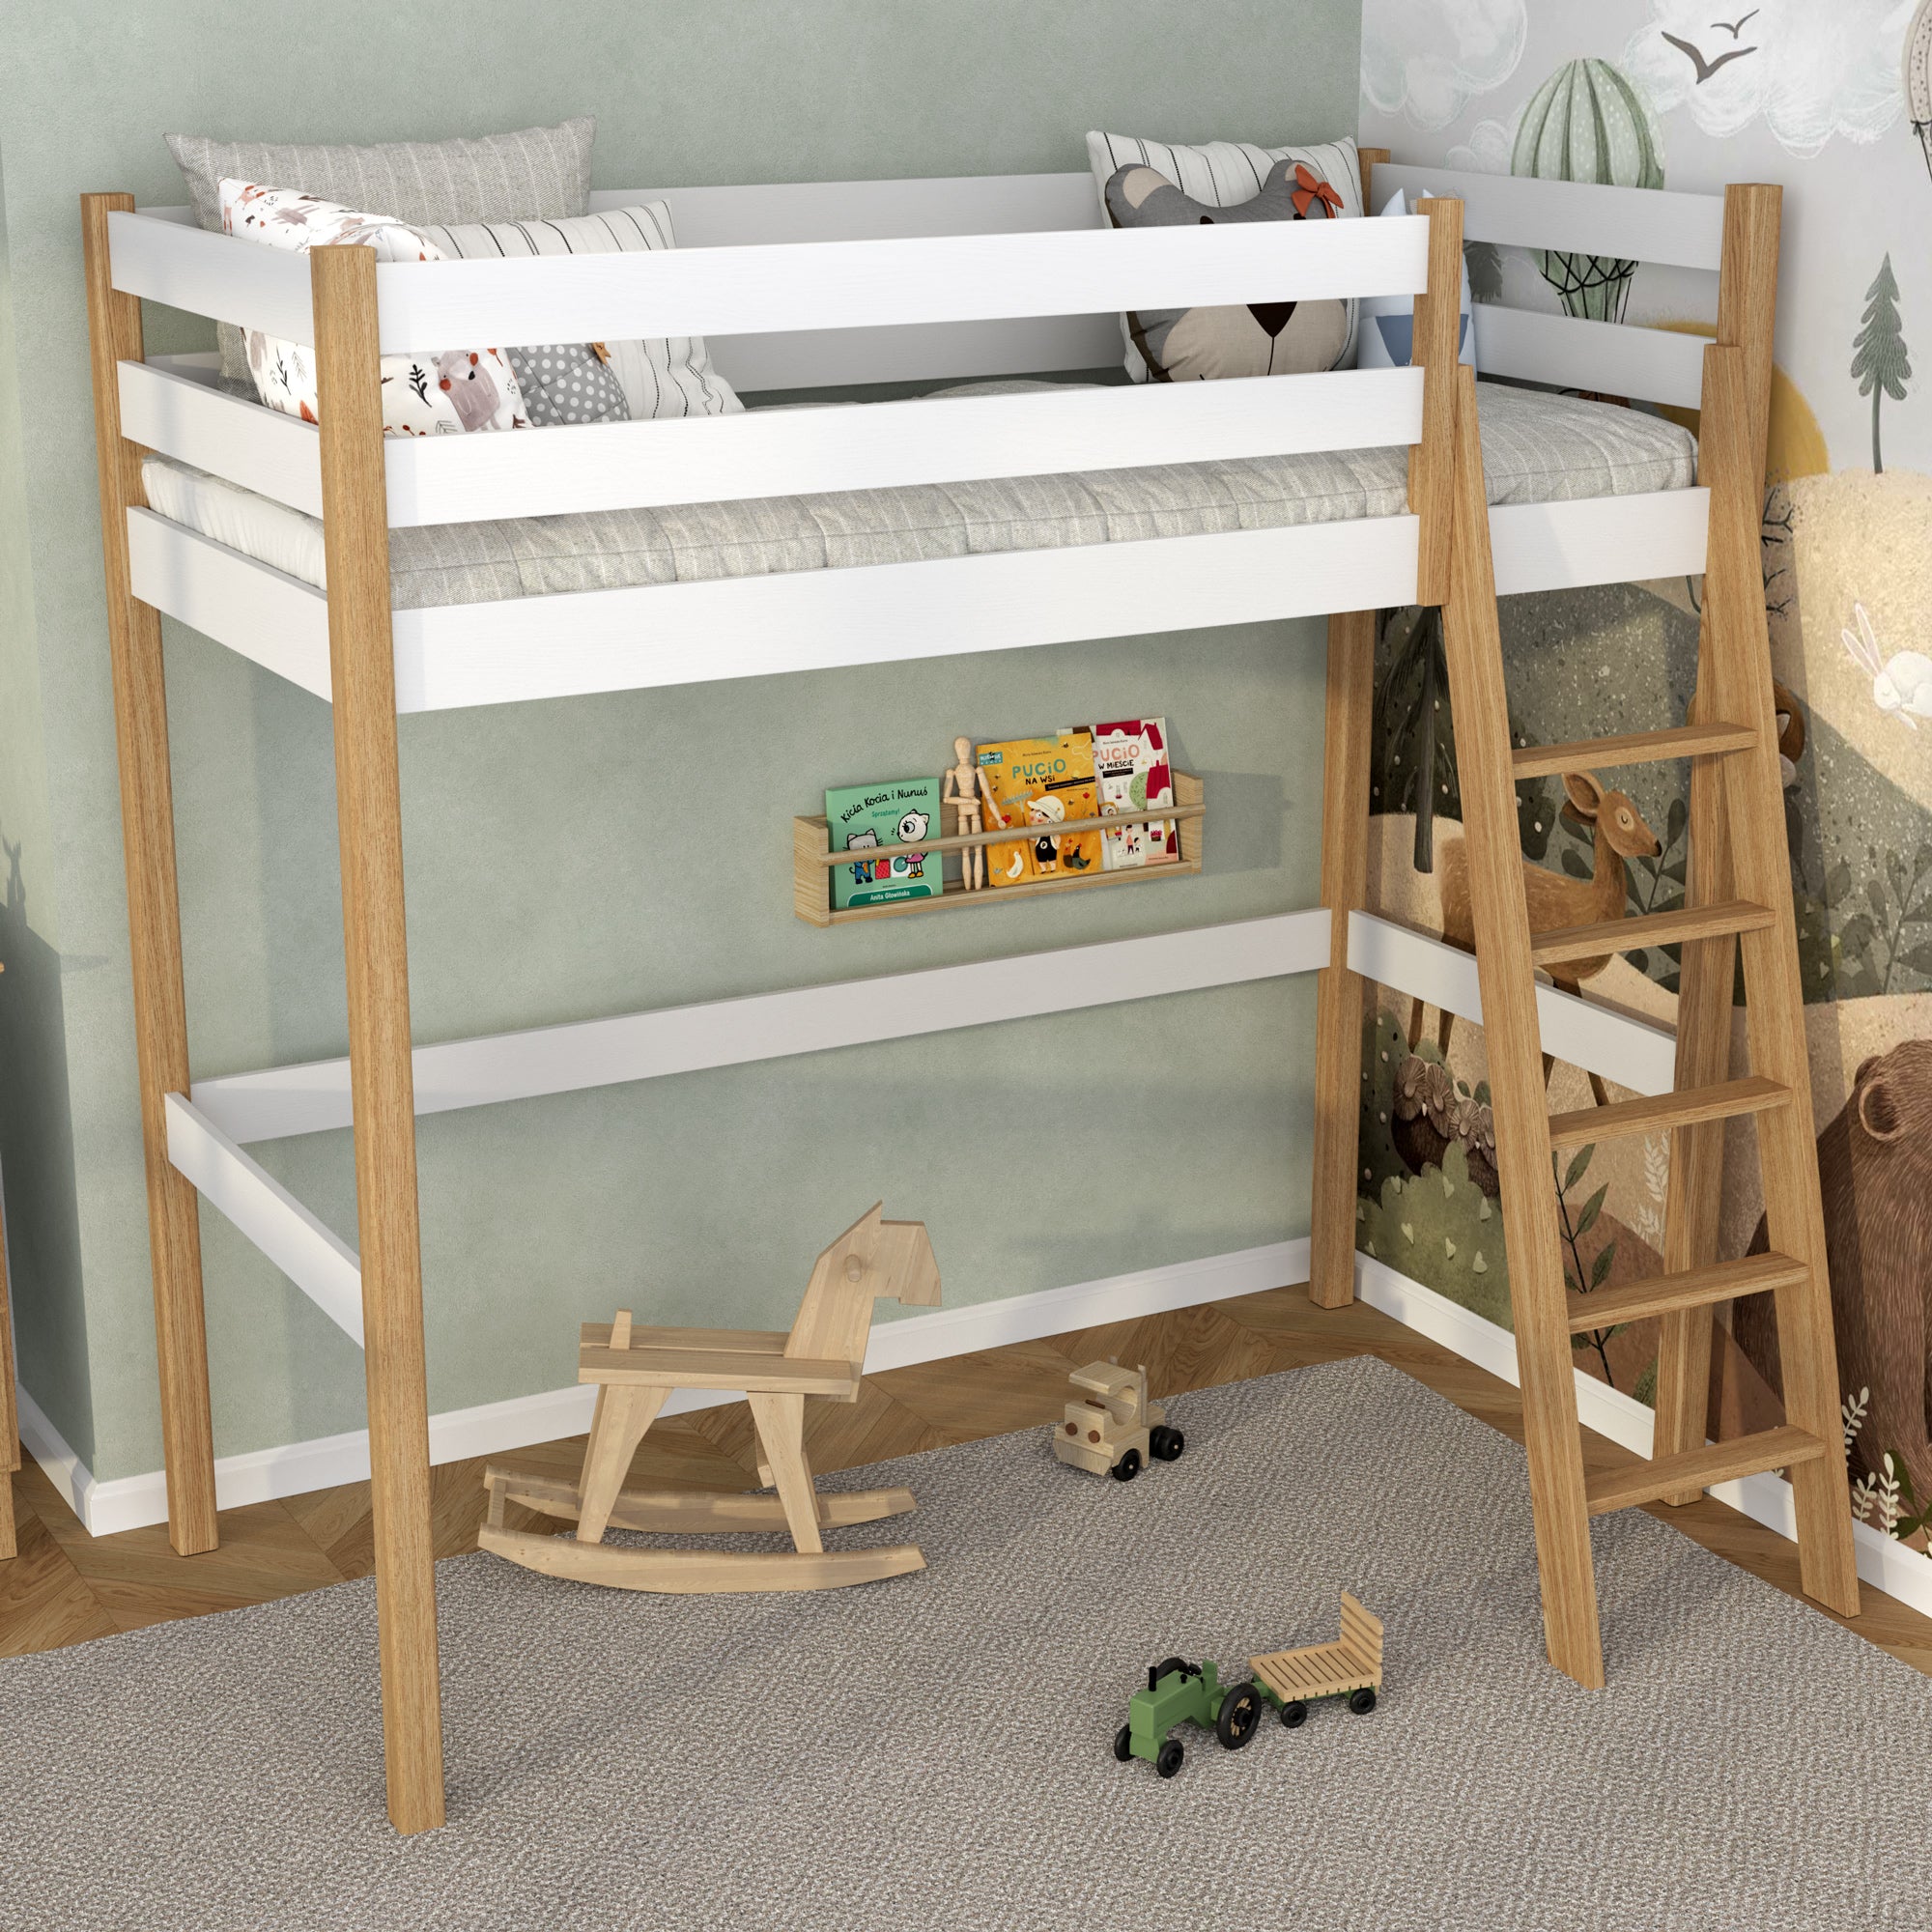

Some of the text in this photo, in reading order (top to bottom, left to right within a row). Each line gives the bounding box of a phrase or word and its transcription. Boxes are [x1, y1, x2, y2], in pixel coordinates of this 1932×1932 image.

[840, 786, 928, 823] Kicia Kocia i Nunuś
